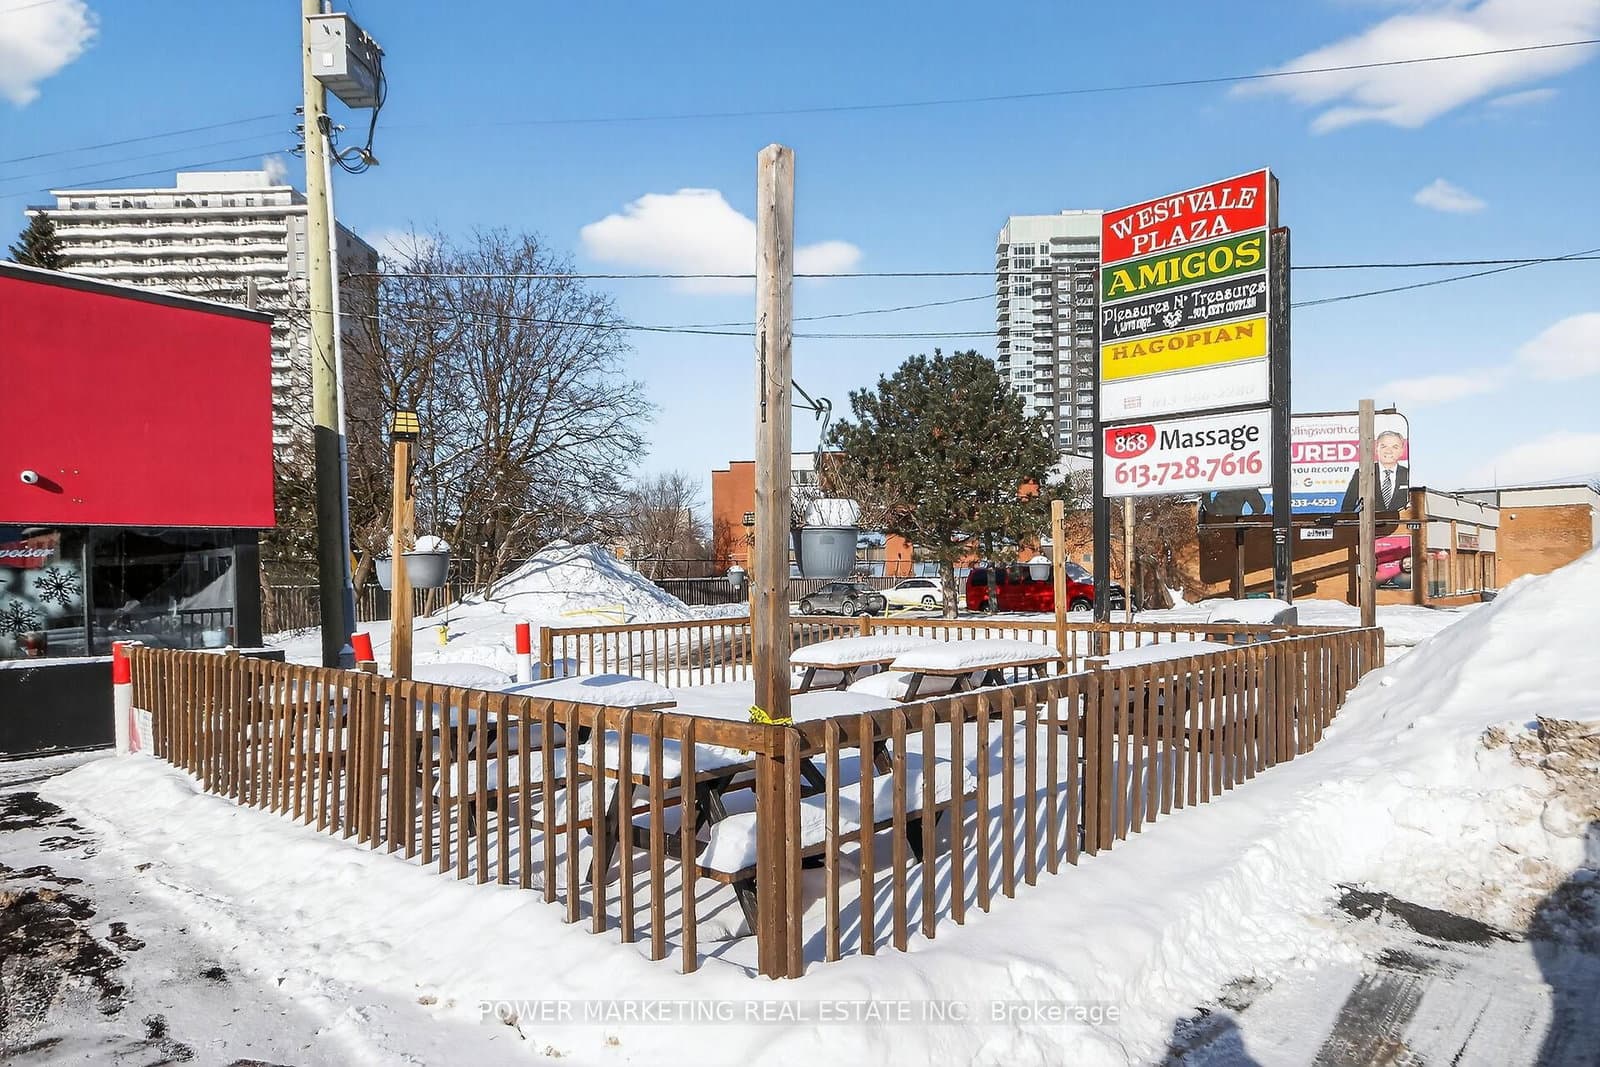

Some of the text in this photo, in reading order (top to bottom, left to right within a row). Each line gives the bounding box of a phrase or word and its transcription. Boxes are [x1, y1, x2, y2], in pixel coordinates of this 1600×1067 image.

[1110, 187, 1257, 240] WESTVALE
[1131, 214, 1231, 255] PLAZA
[1107, 238, 1261, 296] AMIGOS
[1103, 301, 1170, 326] Pleasures
[1191, 281, 1266, 306] Treasures
[1112, 323, 1255, 361] HAGOPIAN
[1114, 434, 1148, 453] 868
[1160, 425, 1259, 451] Massage
[1292, 443, 1359, 461] URED
[1115, 450, 1262, 488] 613.728.7616
